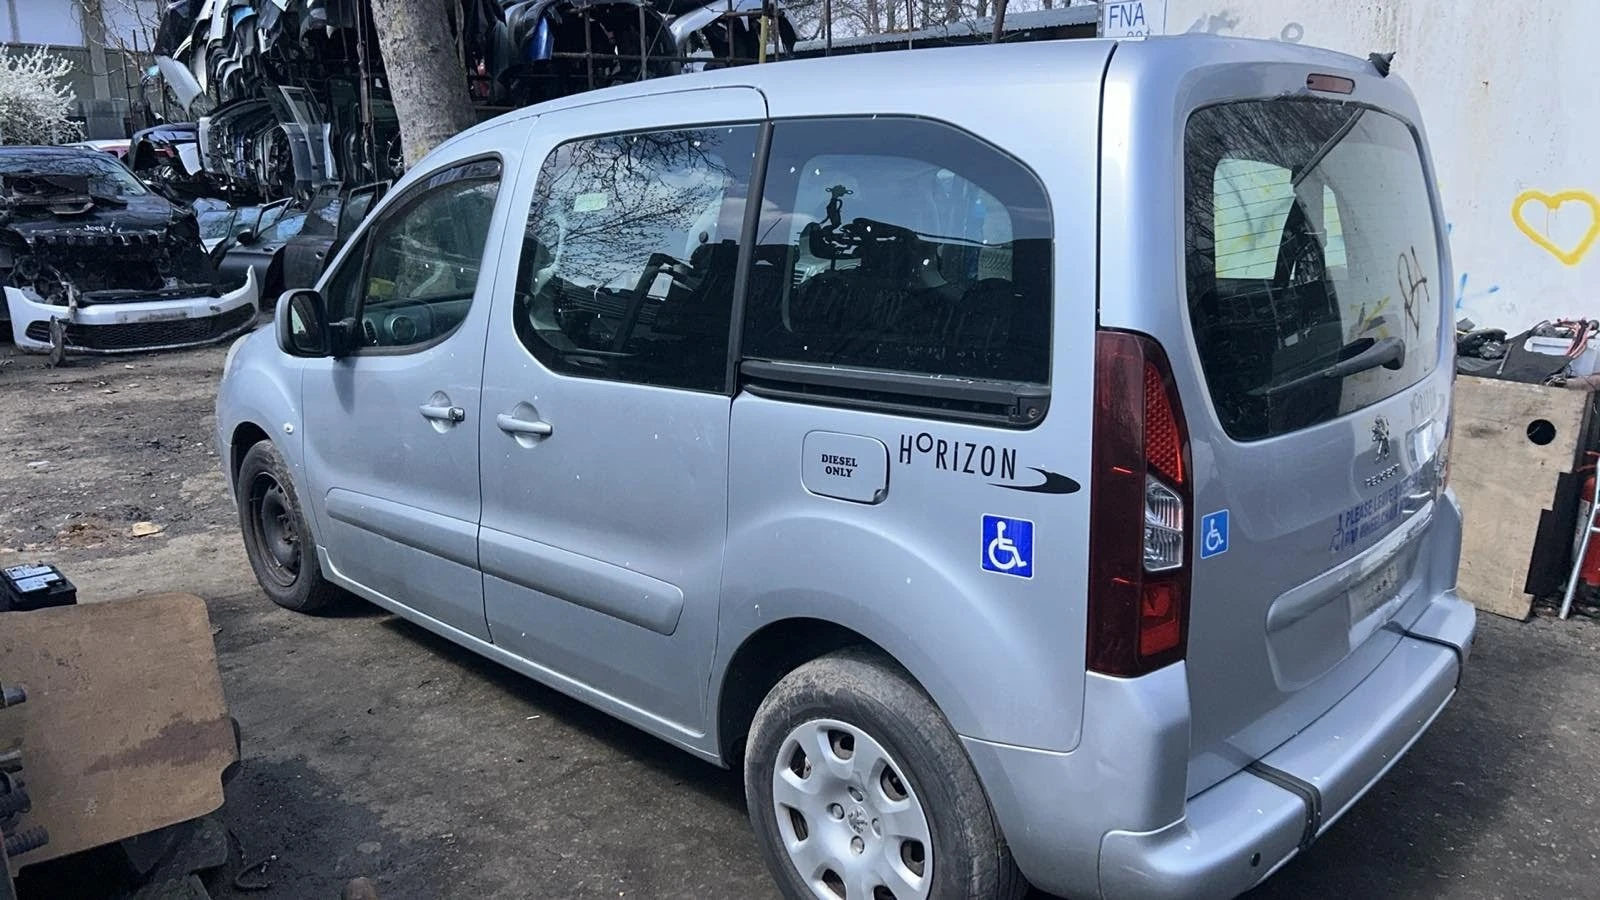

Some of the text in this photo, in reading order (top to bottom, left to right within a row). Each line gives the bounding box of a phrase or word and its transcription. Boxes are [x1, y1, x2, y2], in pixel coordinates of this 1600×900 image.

[1109, 2, 1145, 29] FNA
[83, 224, 106, 232] Jeep
[821, 453, 858, 468] DIESEL
[899, 432, 1017, 480] HORIZON
[825, 466, 853, 478] ONLY
